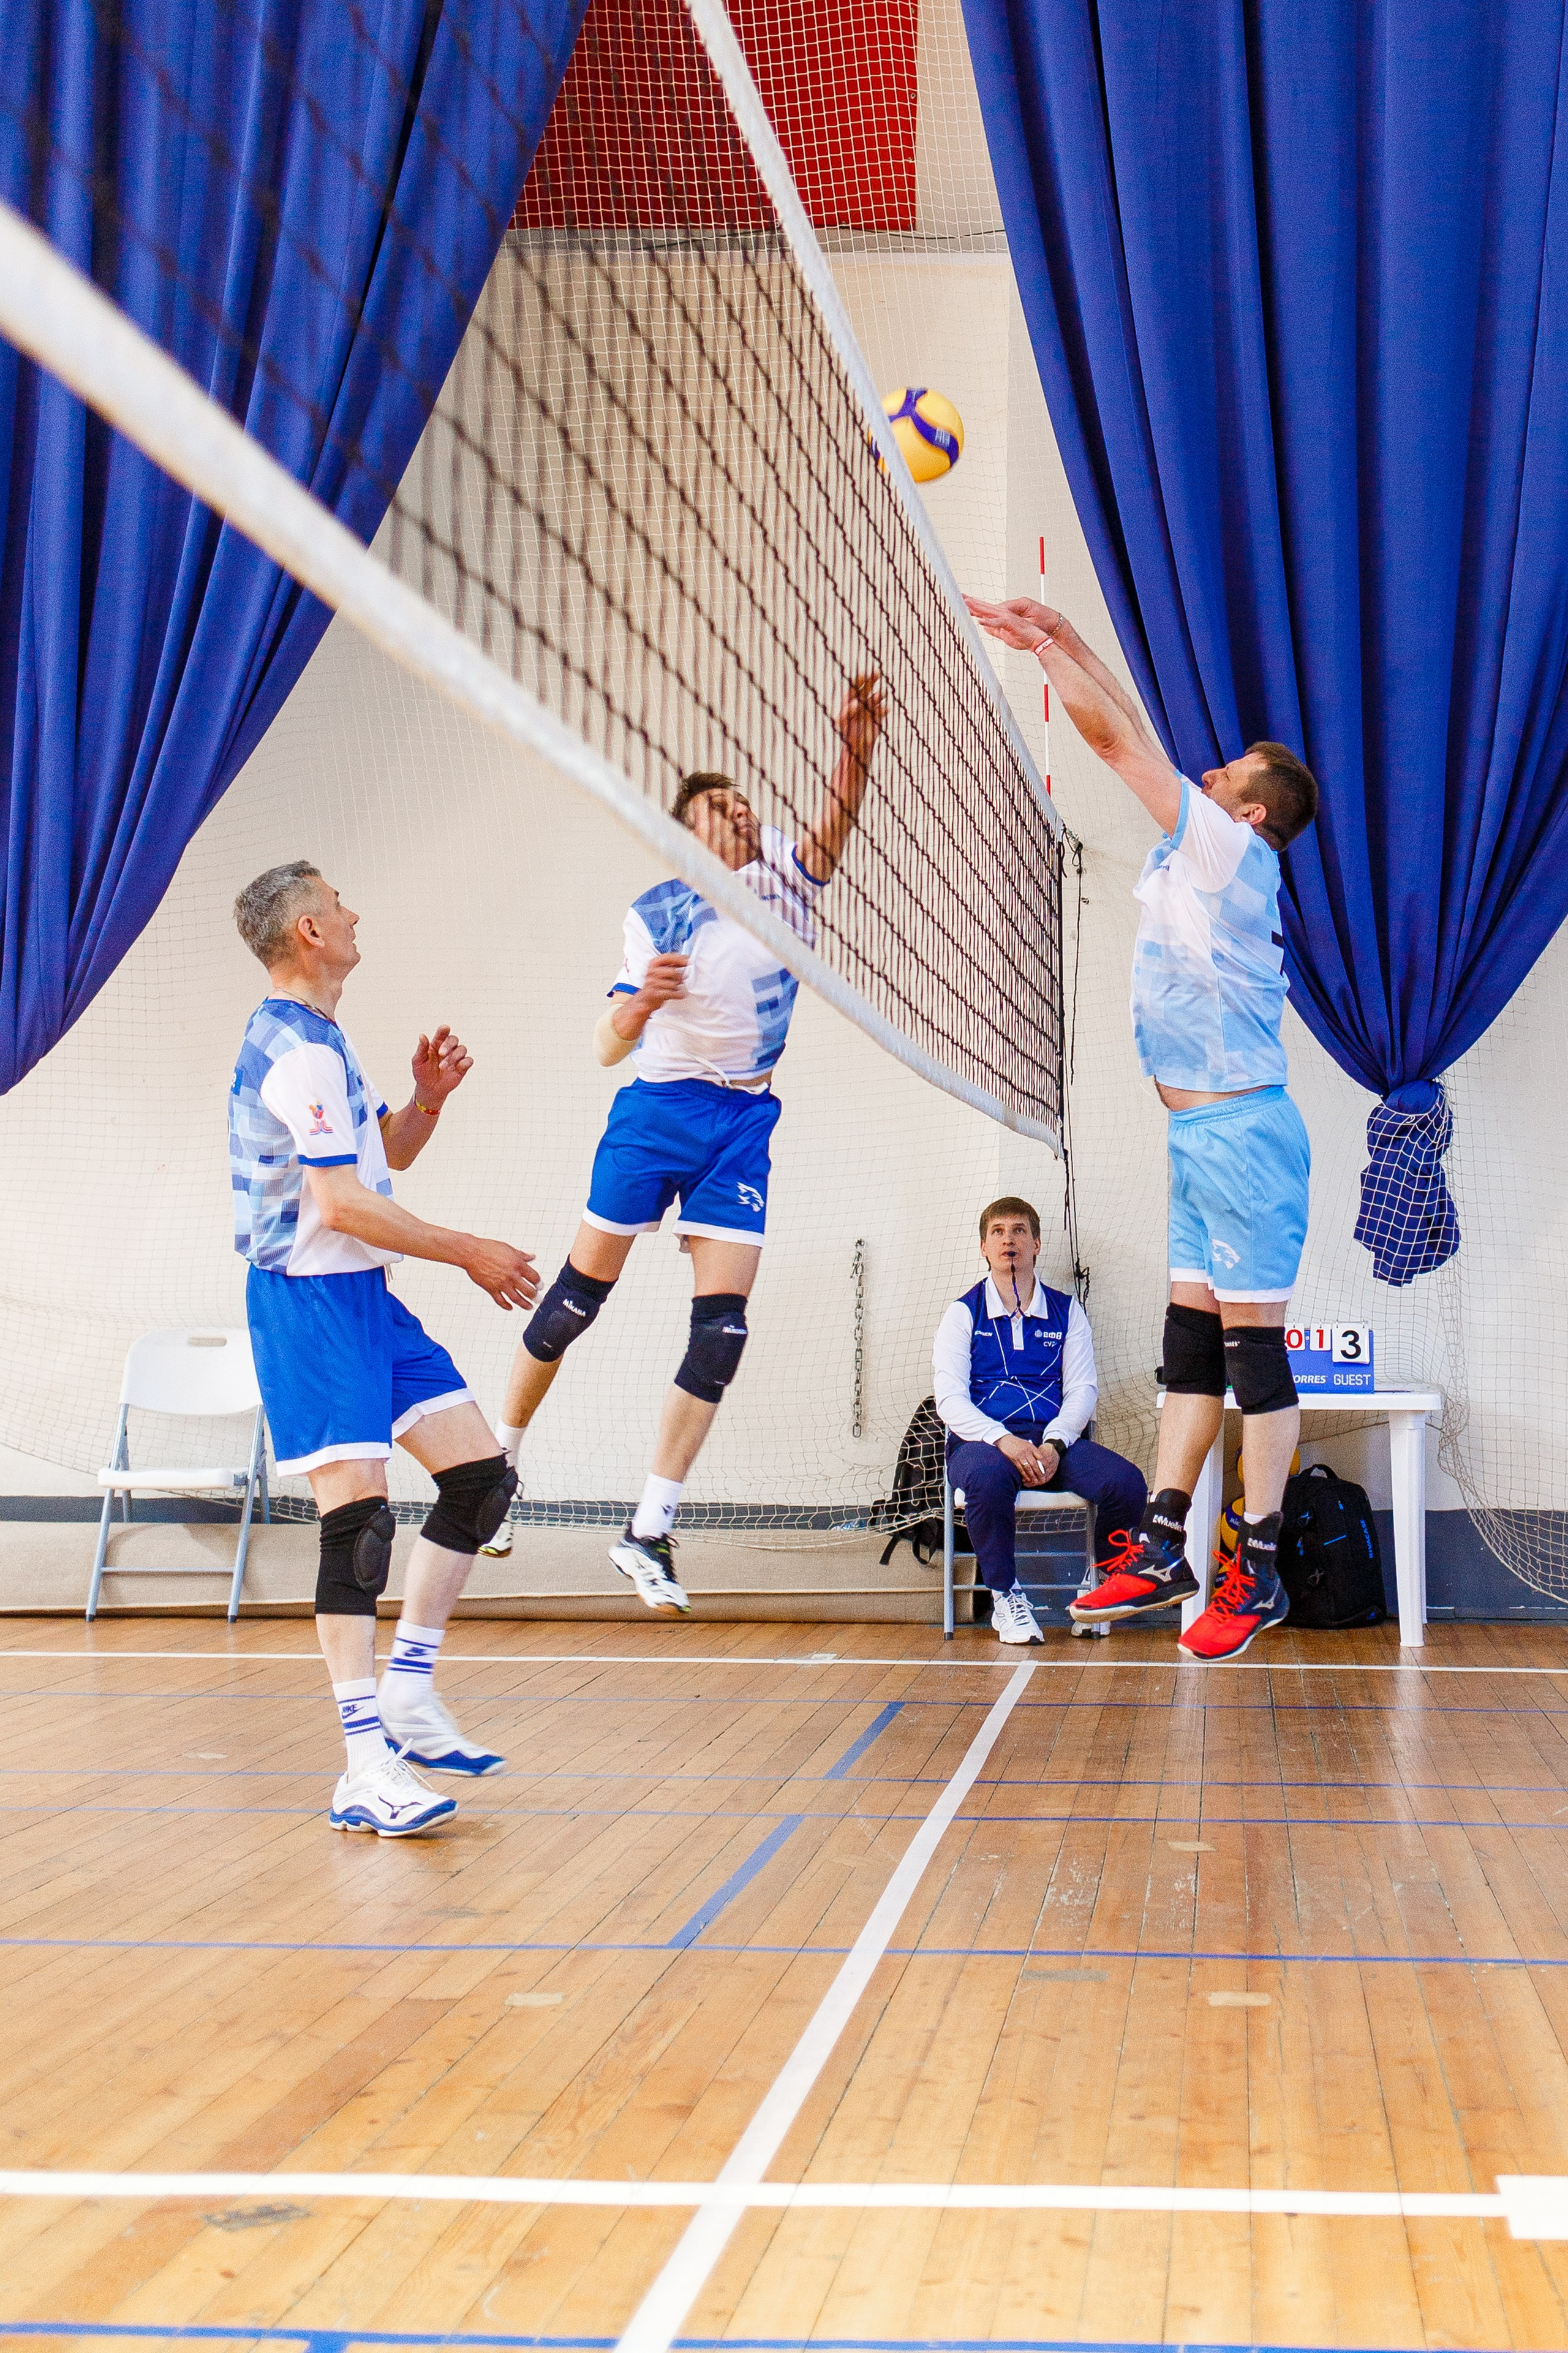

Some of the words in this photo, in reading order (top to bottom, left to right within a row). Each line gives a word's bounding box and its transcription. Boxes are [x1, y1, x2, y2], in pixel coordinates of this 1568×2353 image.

[1286, 1329, 1303, 1348] 0
[1316, 1329, 1324, 1348] 1
[1340, 1330, 1362, 1359] 3
[1293, 1375, 1327, 1384] ORRES
[1333, 1373, 1371, 1386] GUEST
